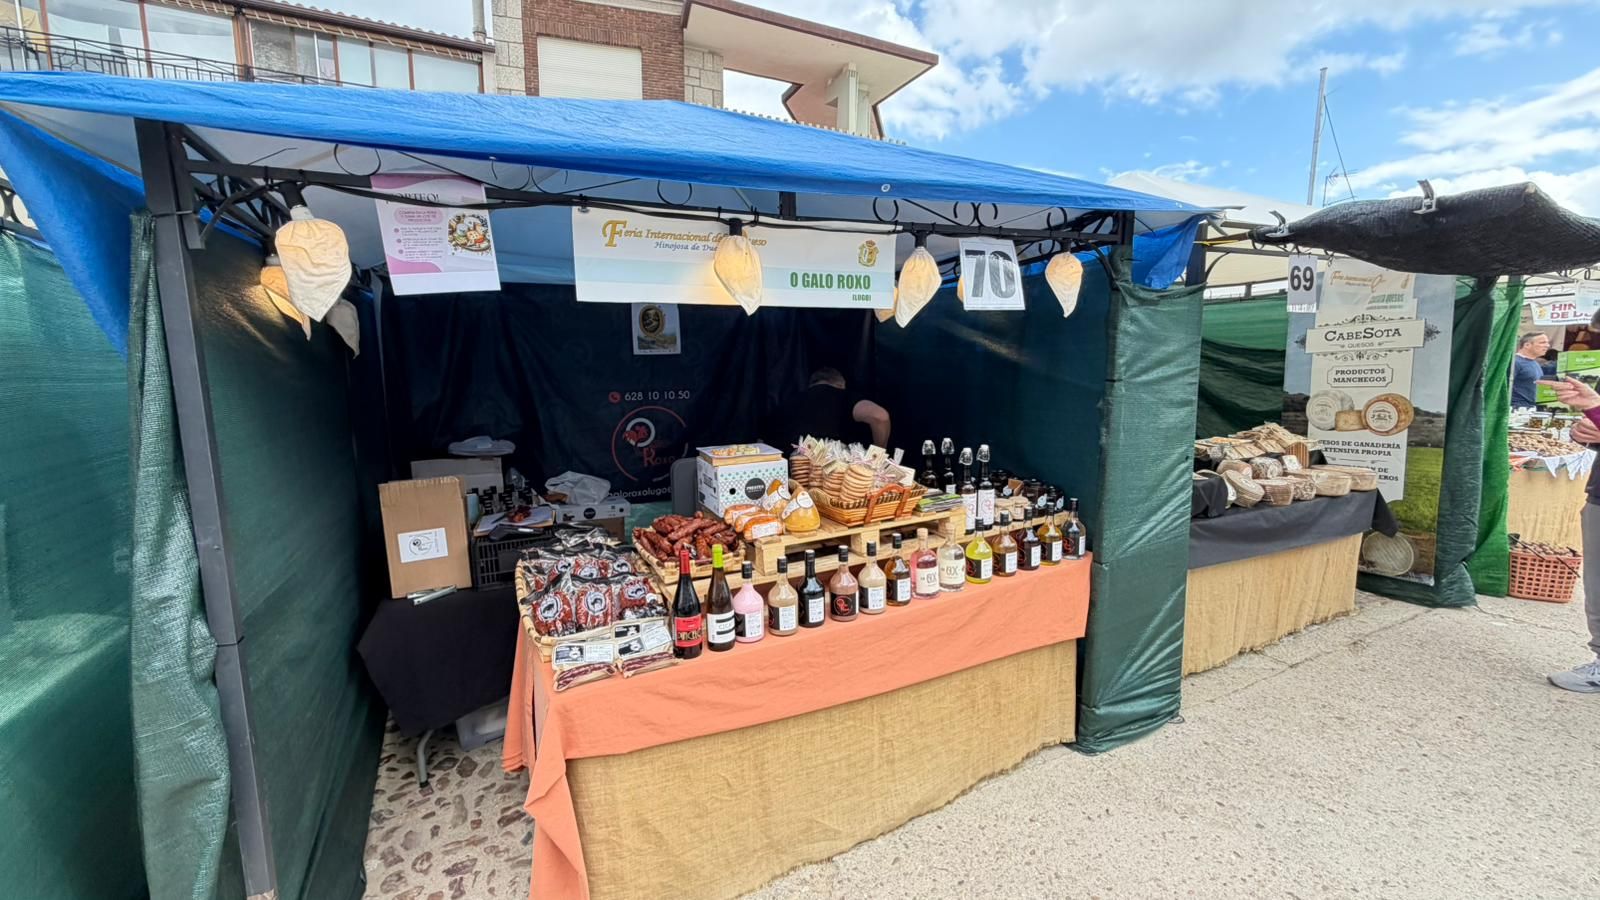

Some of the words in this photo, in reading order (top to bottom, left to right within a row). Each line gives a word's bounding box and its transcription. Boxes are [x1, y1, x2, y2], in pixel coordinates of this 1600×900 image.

[602, 219, 643, 247] Feria
[645, 229, 710, 243] Internacional
[654, 241, 689, 252] Hinojosa
[691, 243, 700, 251] de
[703, 244, 718, 252] Due
[790, 271, 798, 288] O
[802, 272, 834, 289] GALO
[837, 274, 871, 290] ROXO
[965, 249, 1016, 299] 70
[1290, 265, 1314, 291] 69
[624, 391, 643, 401] 628
[648, 391, 660, 400] 10
[664, 390, 675, 400] 10
[678, 390, 690, 399] 50
[1321, 447, 1360, 455] XTENSIVA
[1361, 449, 1392, 457] PROPIA
[1353, 441, 1401, 449] GANADERÍA
